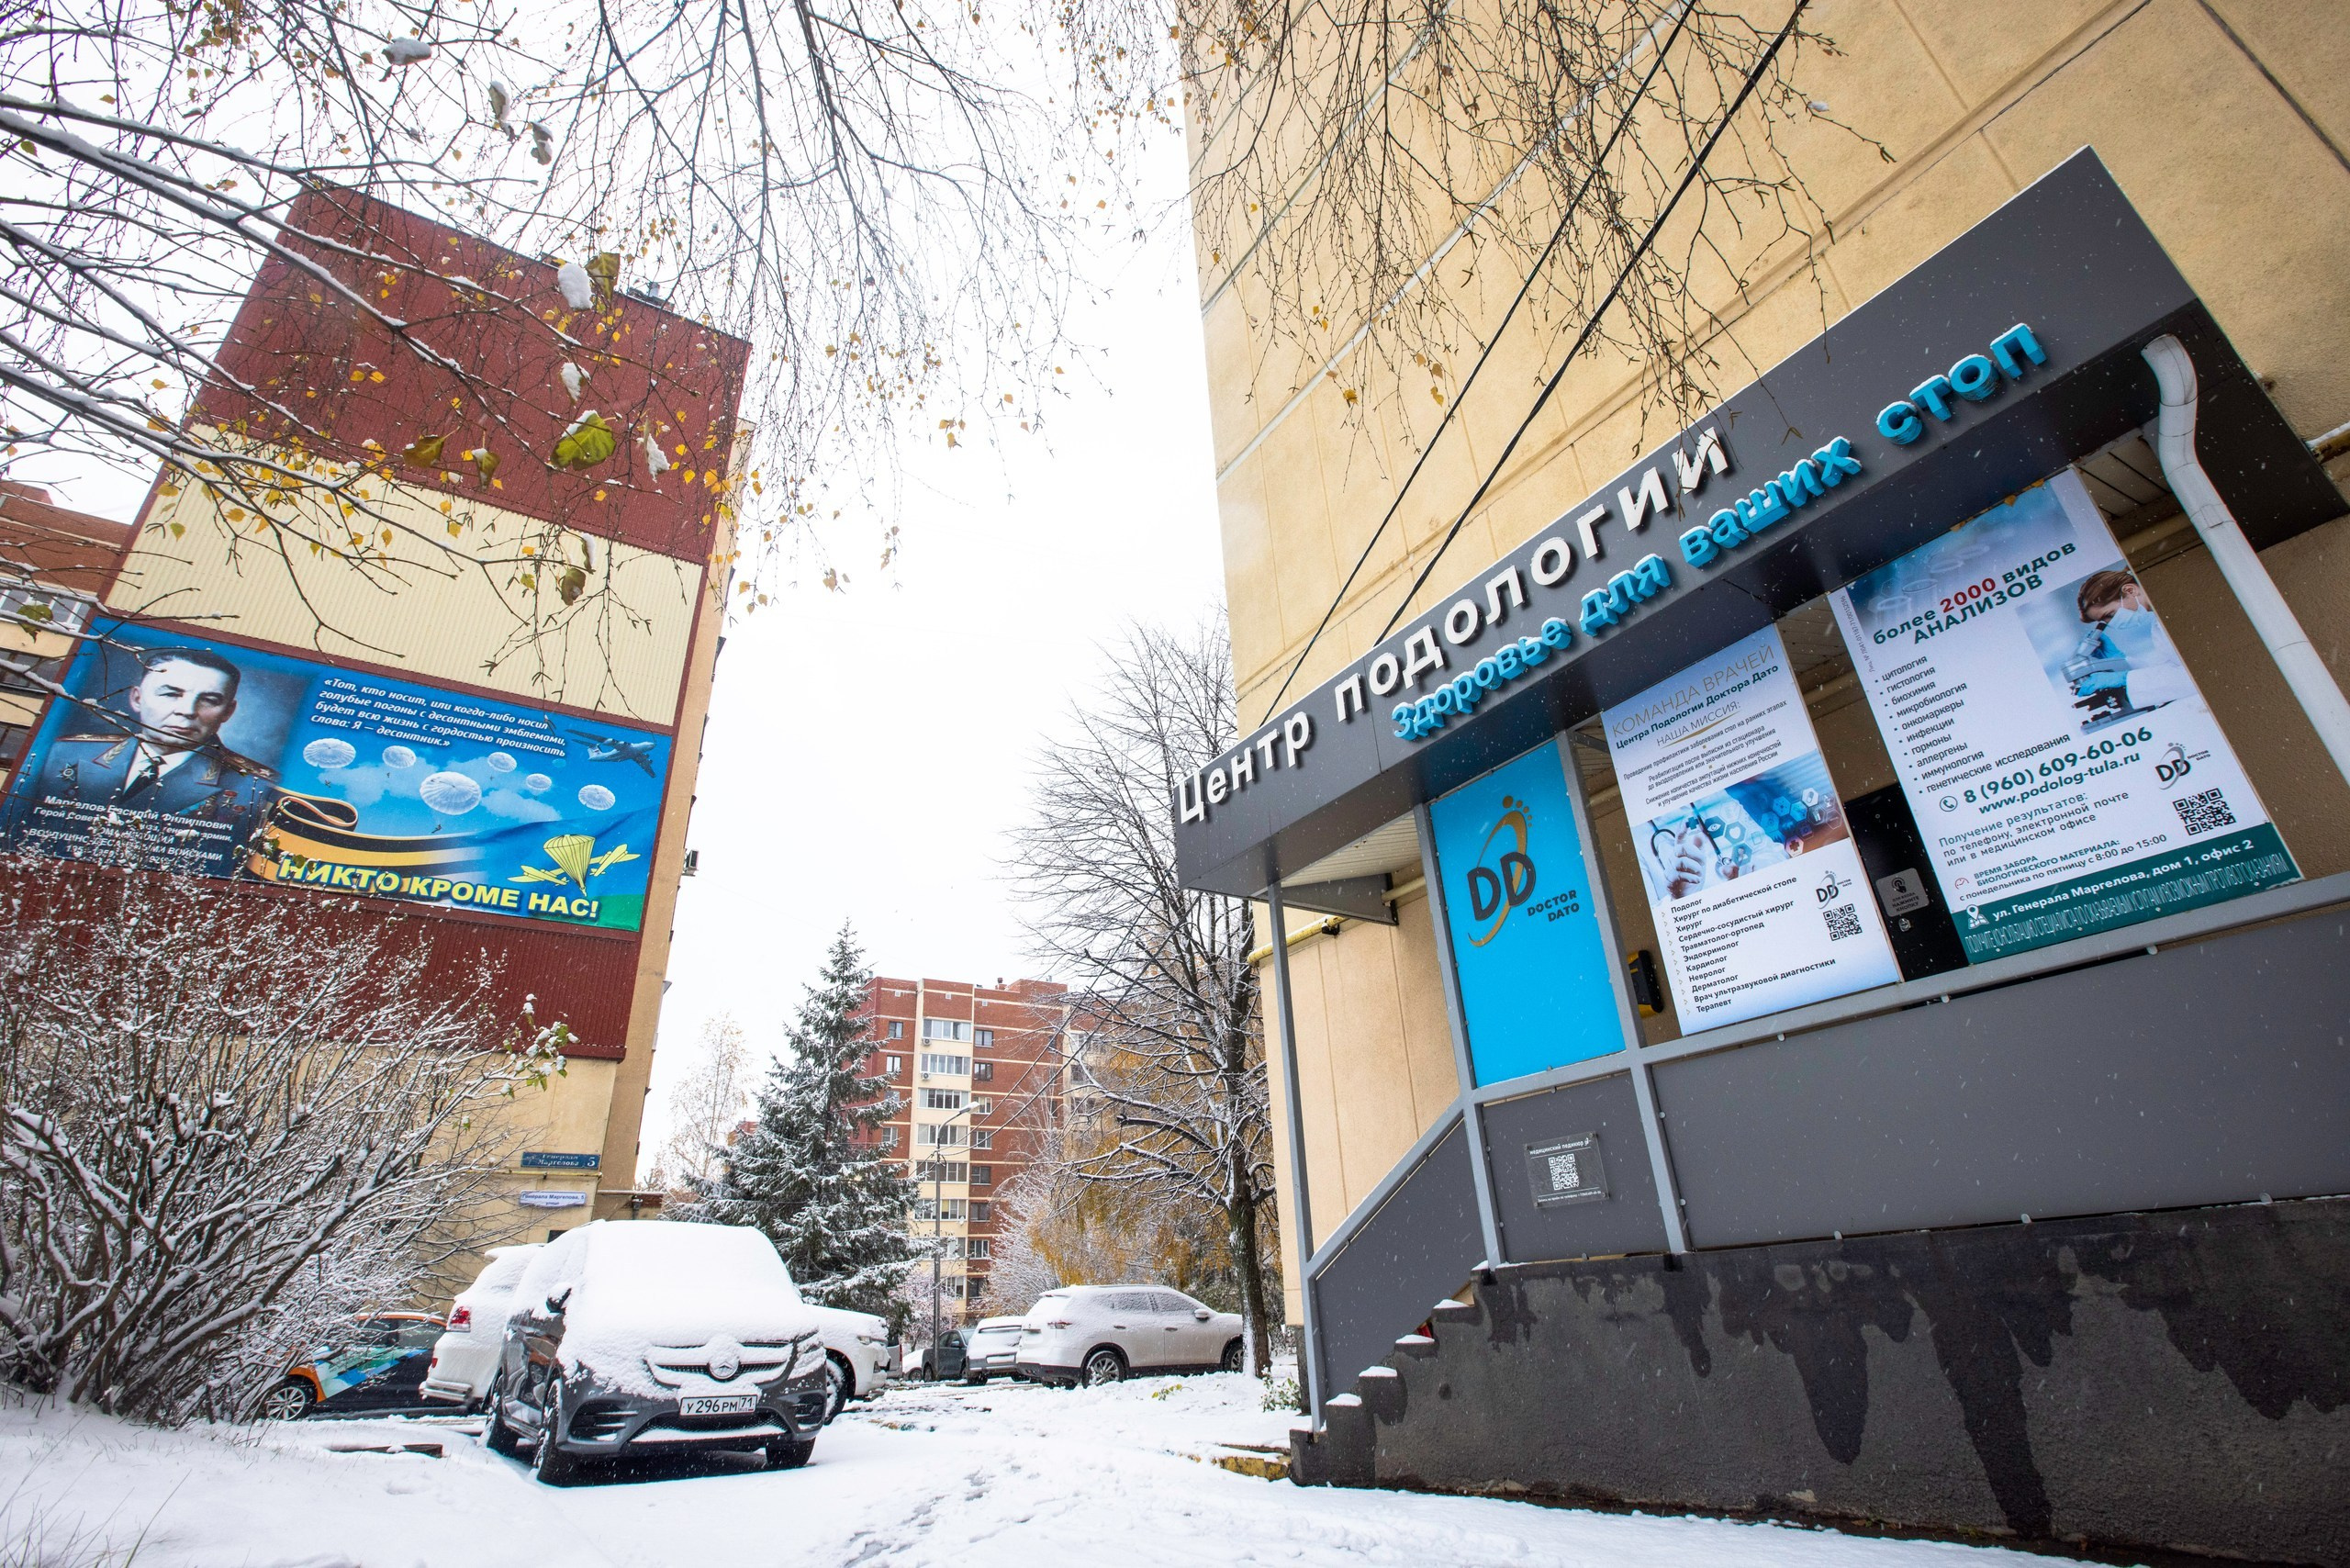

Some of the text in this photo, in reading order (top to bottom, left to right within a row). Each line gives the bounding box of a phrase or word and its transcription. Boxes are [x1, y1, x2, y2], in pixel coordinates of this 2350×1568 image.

[1391, 322, 2048, 742] Здоровье для ваших стоп
[1873, 543, 2077, 644] более 2000 видов
[1914, 574, 2043, 644] АНАЛИЗОВ
[1612, 644, 1774, 738] КОМАНДА ВРАЧЕЙ
[1882, 655, 1928, 681] цитология
[1886, 666, 1936, 693] гистология
[324, 678, 548, 730] «Тот, кто носит, или когда-либо носил
[1616, 666, 1778, 749] Центра Подологии Доктора Дато
[1891, 681, 1936, 705] биохимия
[1897, 682, 1967, 718] микробиология
[1901, 700, 1964, 731] онкомаркеры
[310, 714, 450, 747] слова: Я десантник.»
[315, 700, 355, 716] будет
[357, 711, 381, 721] всю
[383, 715, 420, 729] жизнь
[431, 725, 494, 743] гордостью
[496, 737, 565, 757] произносить
[319, 690, 372, 706] голубые
[374, 701, 418, 716] погоны
[429, 711, 501, 732] десантными
[503, 726, 565, 746] эмблемами,
[1623, 700, 1787, 780] Проведение профилактики заболевания стоп ранних этапах
[1656, 700, 1741, 746] НАША МИССИЯ:
[1907, 718, 1954, 743] инфекции
[1175, 711, 1311, 824] Центр
[1649, 725, 1765, 782] Реабилитация после выписки стационара
[1655, 728, 1776, 788] выздоровления или значительного улучшения
[1911, 734, 1952, 755] гормоны
[1917, 742, 1968, 767] аллергены
[1921, 751, 1985, 780] иммунология
[1926, 734, 2071, 793] генетические исследования
[1964, 726, 2153, 803] 8 (960) 609-60-06
[1645, 739, 1782, 804] Снижение количества ампутаций нижних конечностей
[1662, 751, 1778, 807] улучшение качества жизни населения России
[1978, 752, 2140, 814] www.podolog-tula.ru
[33, 807, 66, 818] Герой
[1939, 792, 2087, 847] Получение результатов:
[1943, 792, 2130, 857] по телефону, электронной почте
[1947, 856, 1966, 867] или
[1981, 827, 2055, 856] медицинском
[2059, 814, 2096, 831] офисе
[1976, 839, 2121, 887] БИОЛОГИЧЕСКОГО МАТЕРИАЛА:
[278, 857, 600, 919] НИКТО КРОМЕ НАС!
[1466, 851, 1537, 922] DD
[1965, 877, 2031, 900] понедельника
[2032, 872, 2045, 880] по
[2046, 859, 2087, 876] пятницу
[2095, 848, 2119, 861] 8:00
[2121, 846, 2134, 855] до
[2135, 834, 2166, 849] 15:00
[1974, 856, 2038, 879] ВРЕМЯ ЗАБОРА
[1992, 839, 2255, 922] ул. Генерала Маргелова, дом 1, офис 2
[1527, 890, 1578, 917] DOCTOR
[1548, 902, 1580, 923] DATO
[1671, 899, 1703, 913] Подолог
[1673, 911, 1700, 924] Хирург
[1712, 884, 1773, 911] диабетической
[1774, 877, 1797, 890] стопе
[1678, 900, 1795, 943] Сердечно-сосудистый хирург
[1676, 920, 1703, 933] Хирург
[1681, 922, 1765, 953] Травматолог-ортопед
[1683, 940, 1740, 962] Эндокринолог
[1685, 955, 1728, 973] Кардиолог
[1688, 966, 1726, 982] Невролог
[1691, 974, 1739, 993] Дерматолог
[1694, 958, 1836, 1003] Врач ультразвуковой диагностики
[1696, 998, 1732, 1014] Терапевт
[587, 1157, 596, 1167] 5
[741, 1397, 753, 1408] 71
